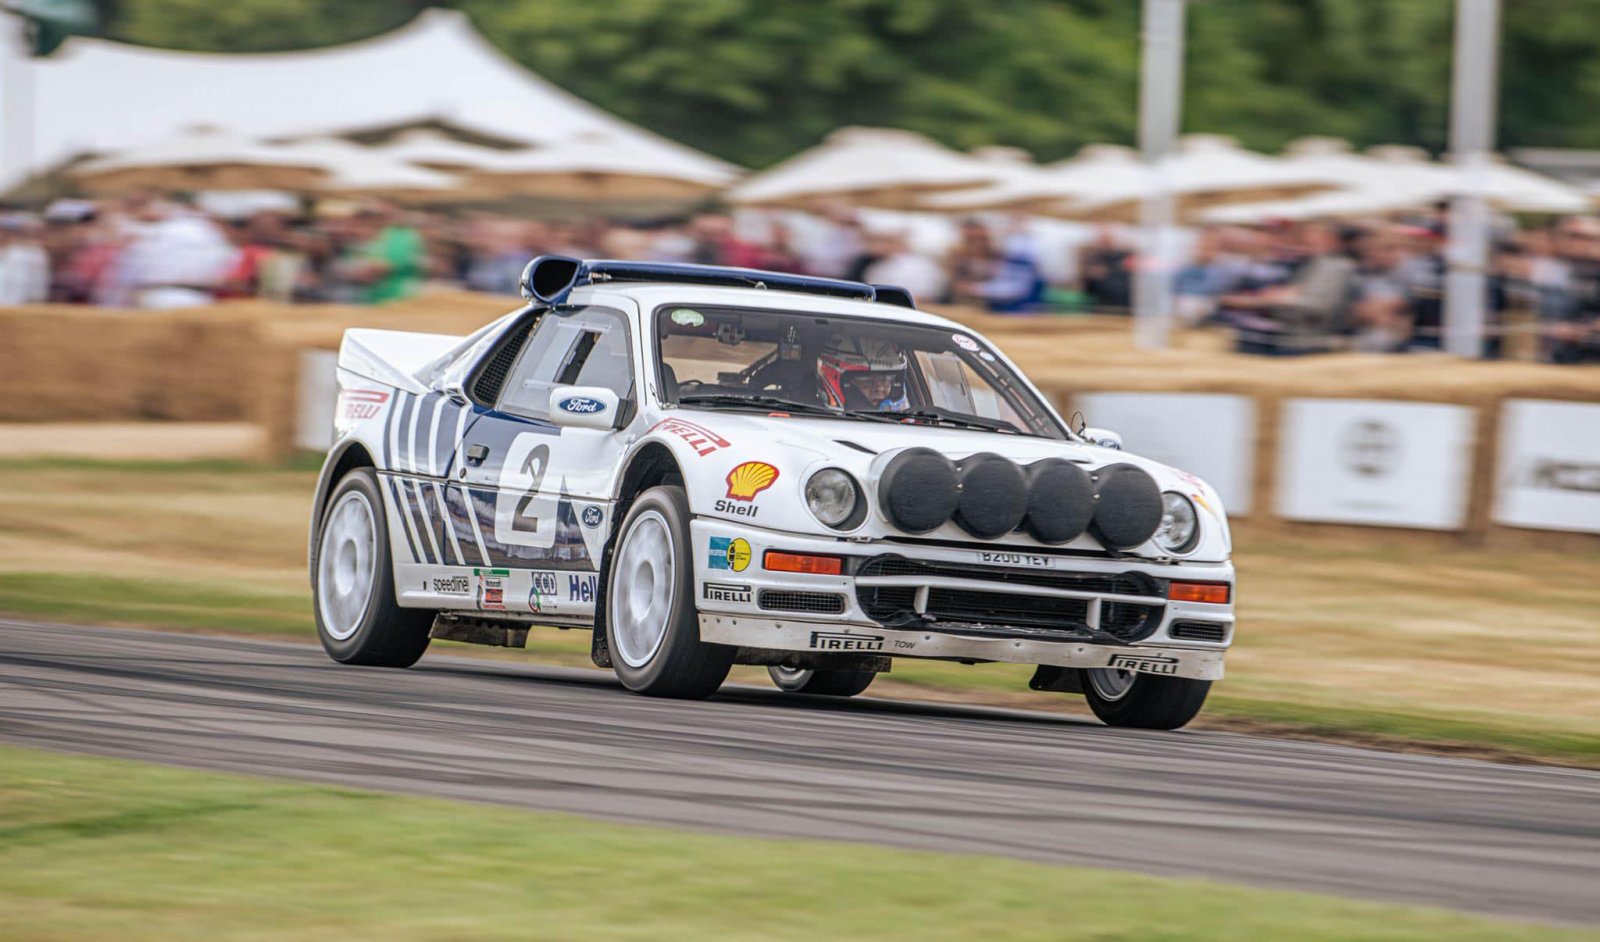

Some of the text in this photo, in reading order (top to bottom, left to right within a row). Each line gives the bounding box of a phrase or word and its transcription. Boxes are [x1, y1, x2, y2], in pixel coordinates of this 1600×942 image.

[567, 398, 597, 412] Ford
[511, 443, 550, 534] 2
[586, 506, 600, 524] Ford
[714, 500, 759, 518] Shell
[703, 581, 752, 603] PIRELLI
[810, 630, 884, 650] PIRELLI
[893, 640, 916, 650] TOW
[1107, 653, 1179, 675] PIRELLI
